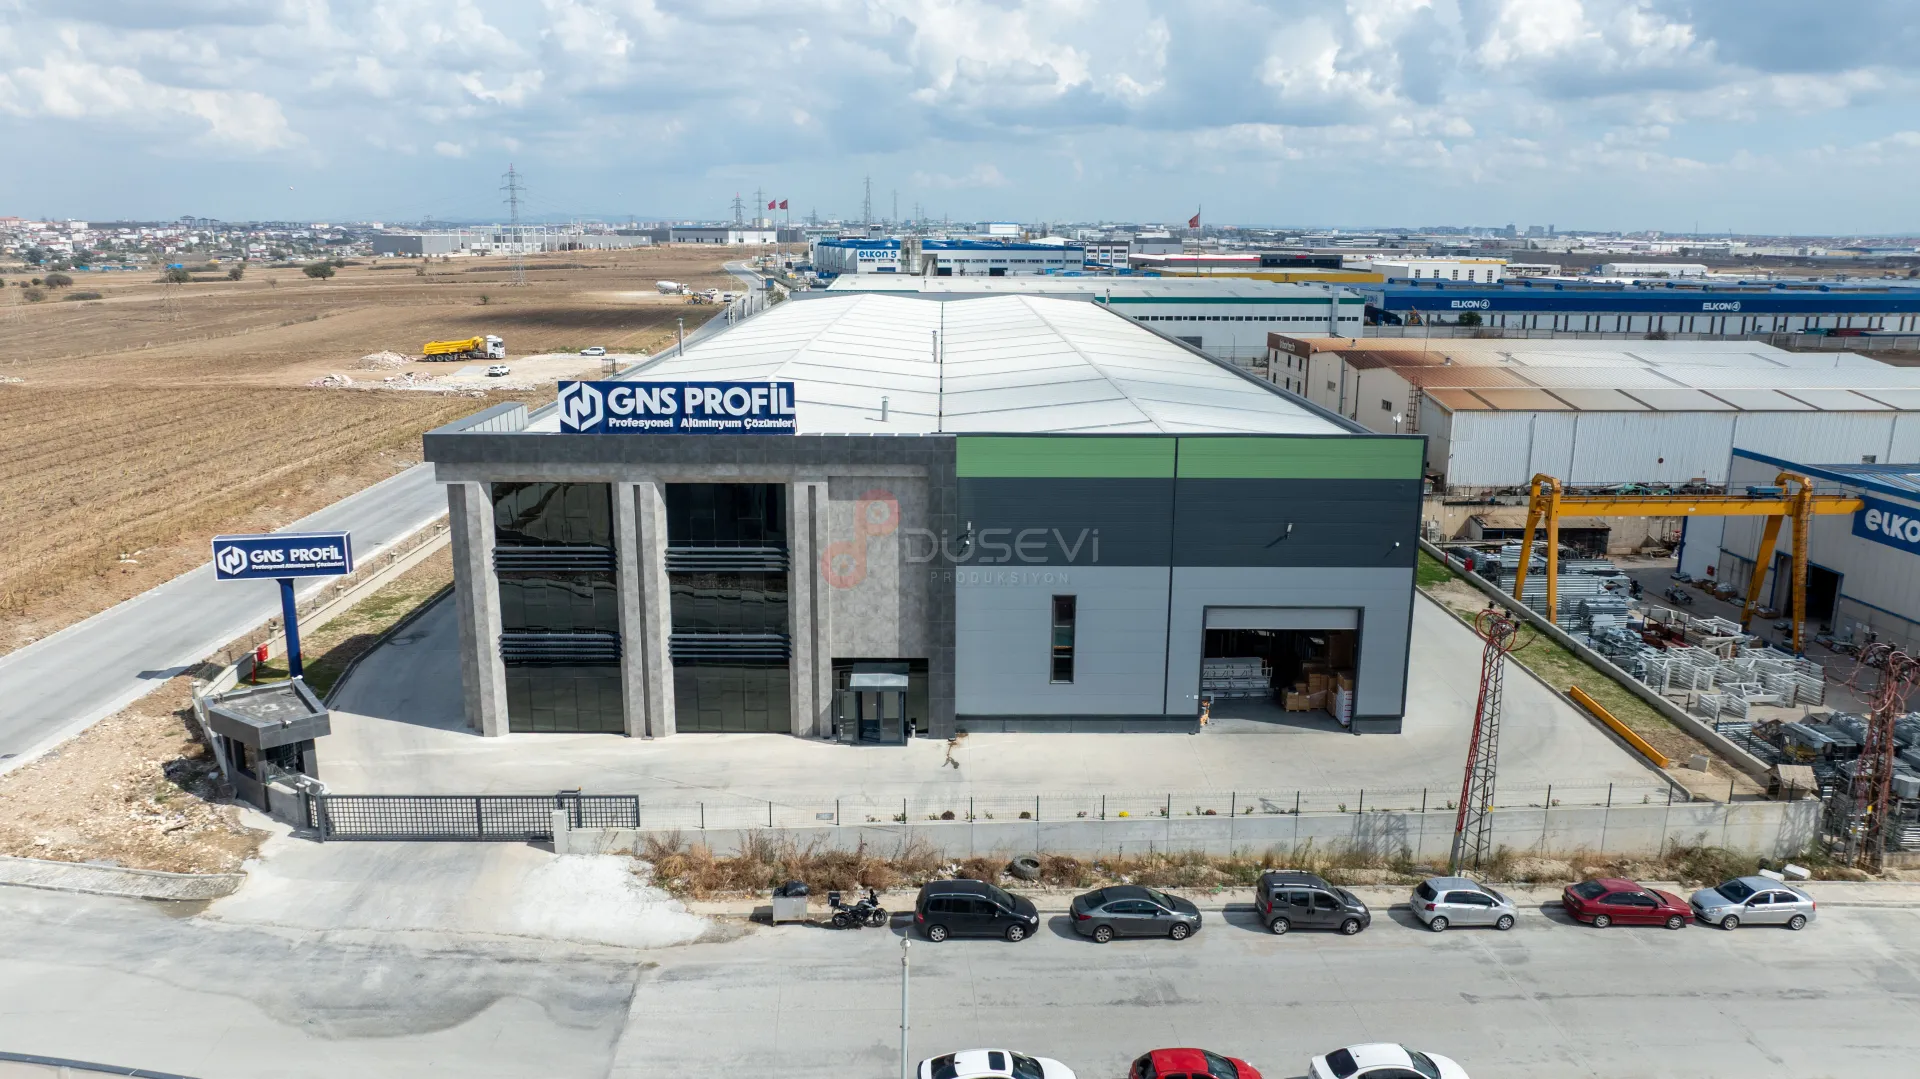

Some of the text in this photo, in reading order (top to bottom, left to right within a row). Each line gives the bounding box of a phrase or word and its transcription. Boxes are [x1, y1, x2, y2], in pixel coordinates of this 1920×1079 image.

[890, 250, 897, 258] 5
[1451, 300, 1480, 308] ELKON
[1702, 302, 1731, 310] ELKON
[607, 386, 678, 415] GNS
[608, 417, 674, 430] Profesyonel
[680, 417, 742, 430] Alüminyum
[249, 549, 285, 563] GNS
